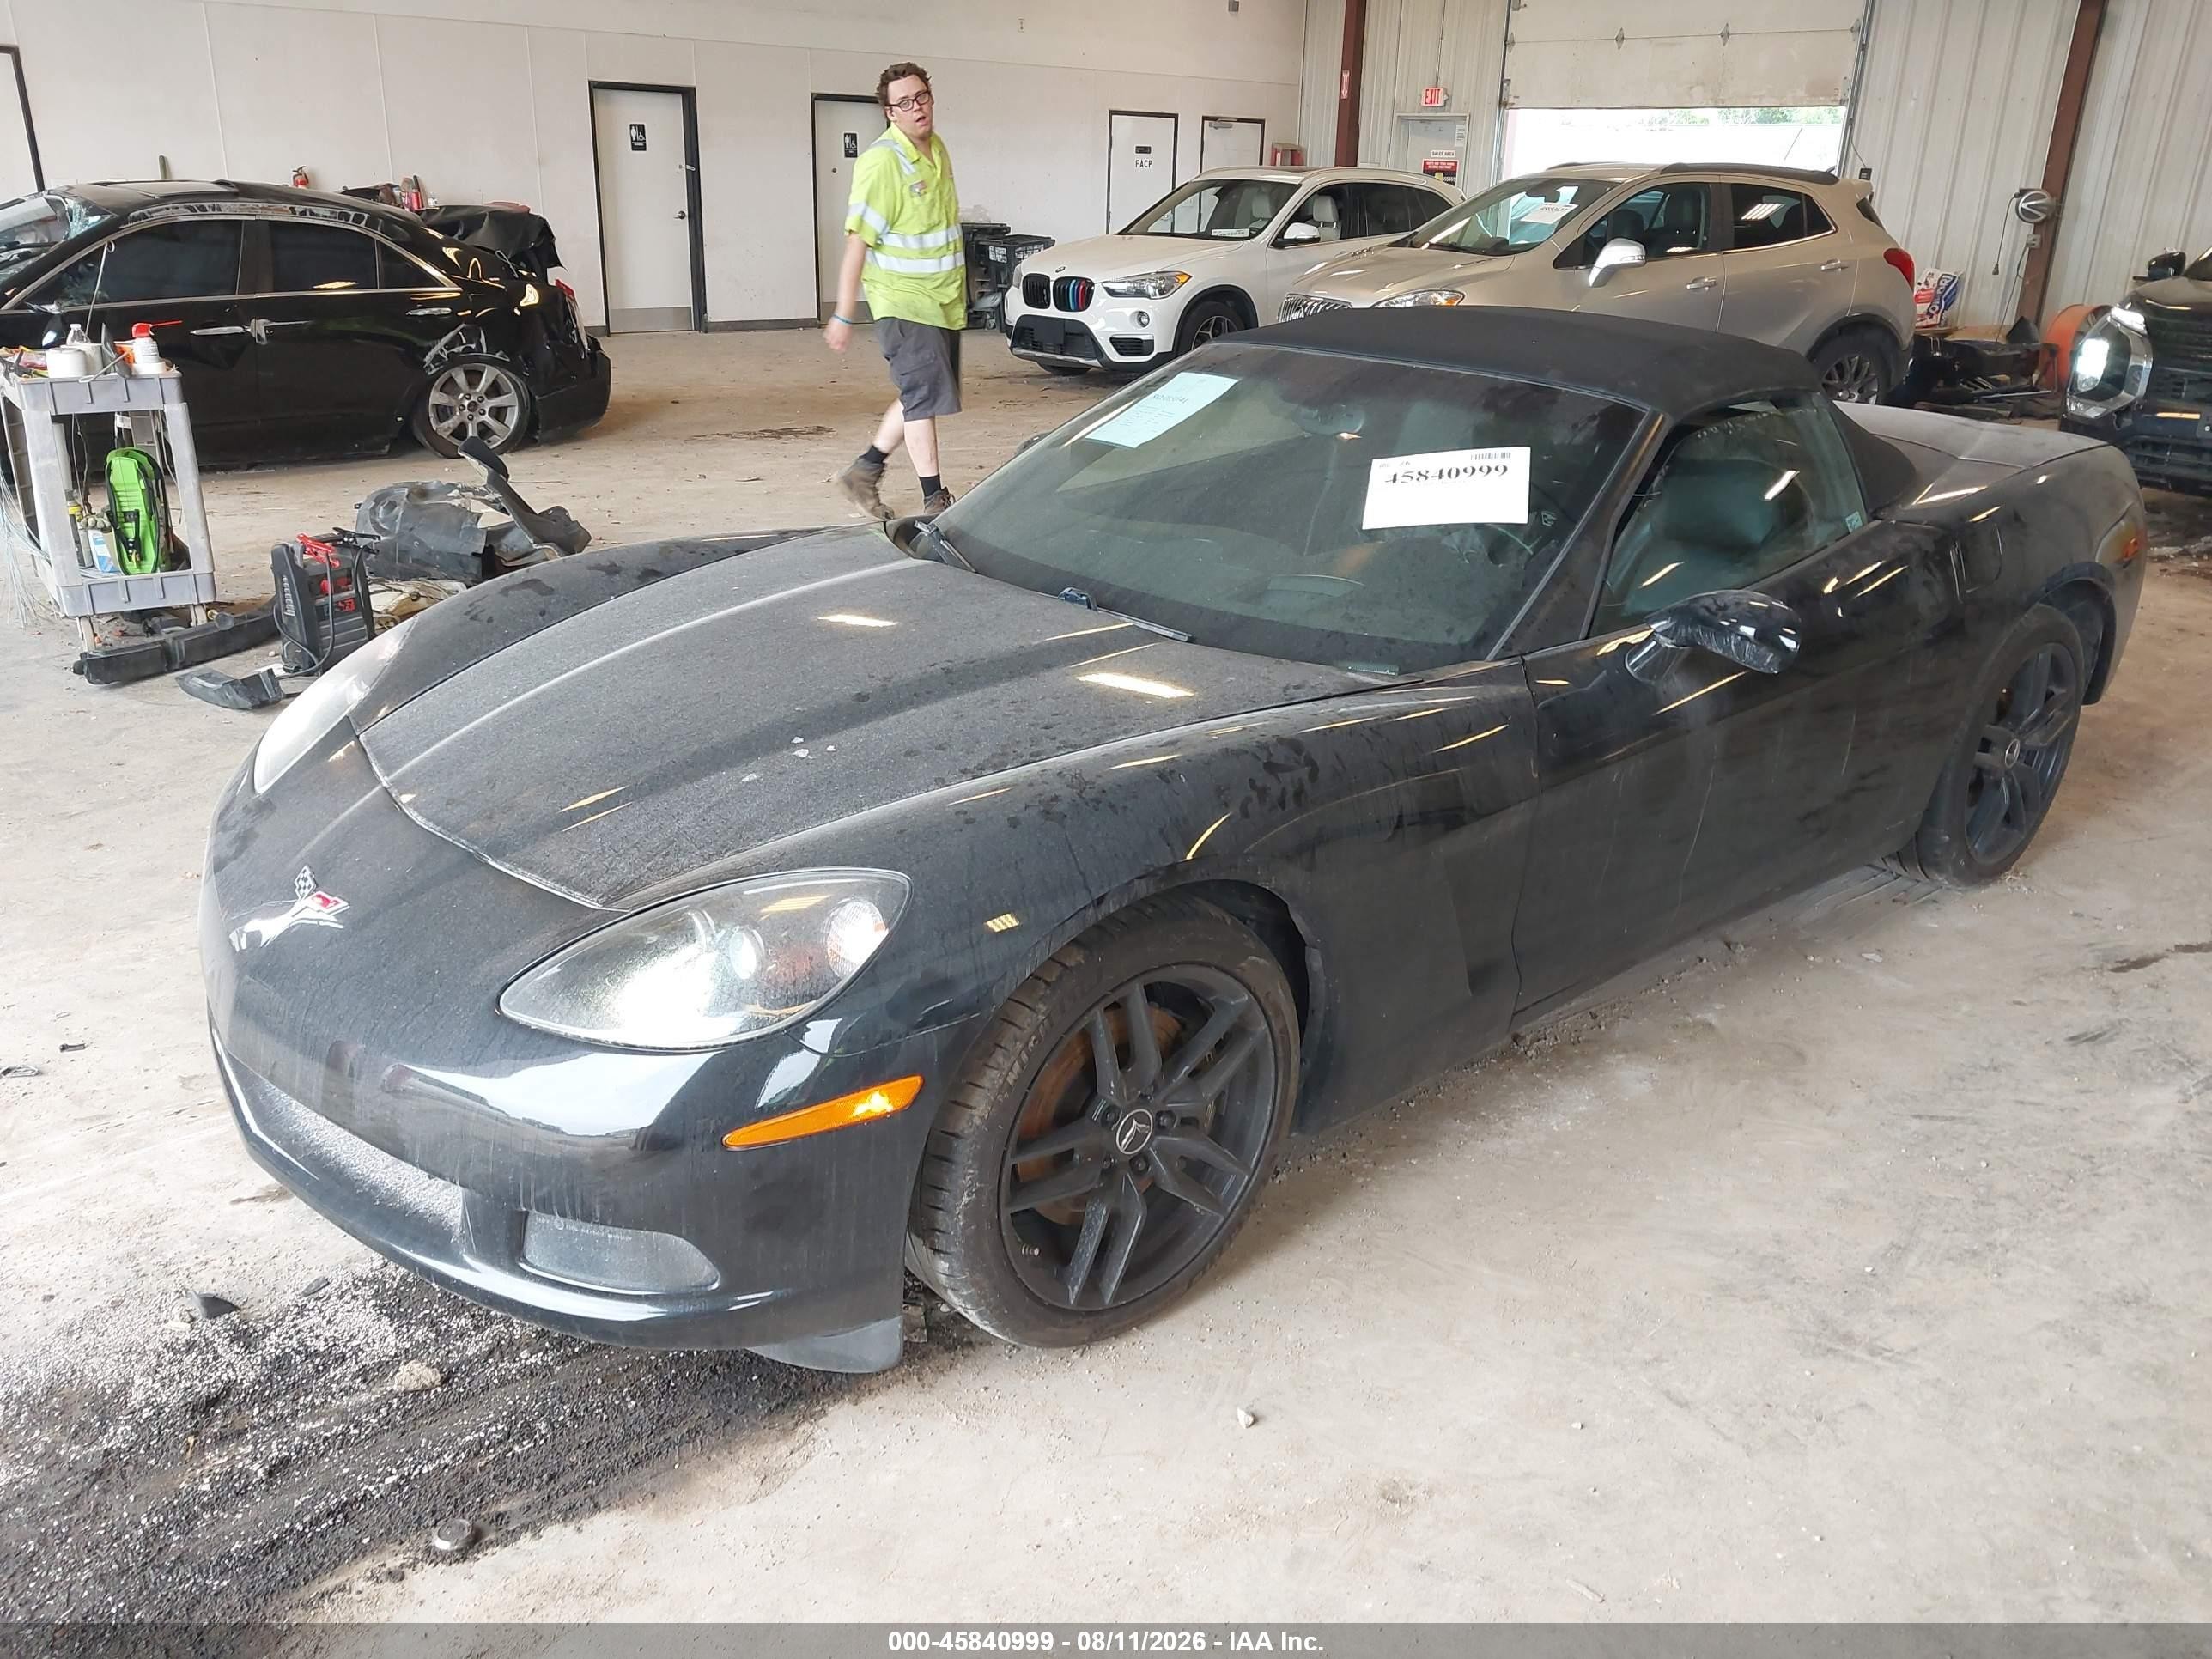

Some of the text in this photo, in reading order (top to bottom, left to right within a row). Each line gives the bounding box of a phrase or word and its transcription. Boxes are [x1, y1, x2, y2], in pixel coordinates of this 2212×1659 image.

[1425, 89, 1441, 104] EXIT
[1135, 159, 1153, 168] FACP
[1385, 464, 1509, 484] 45840999
